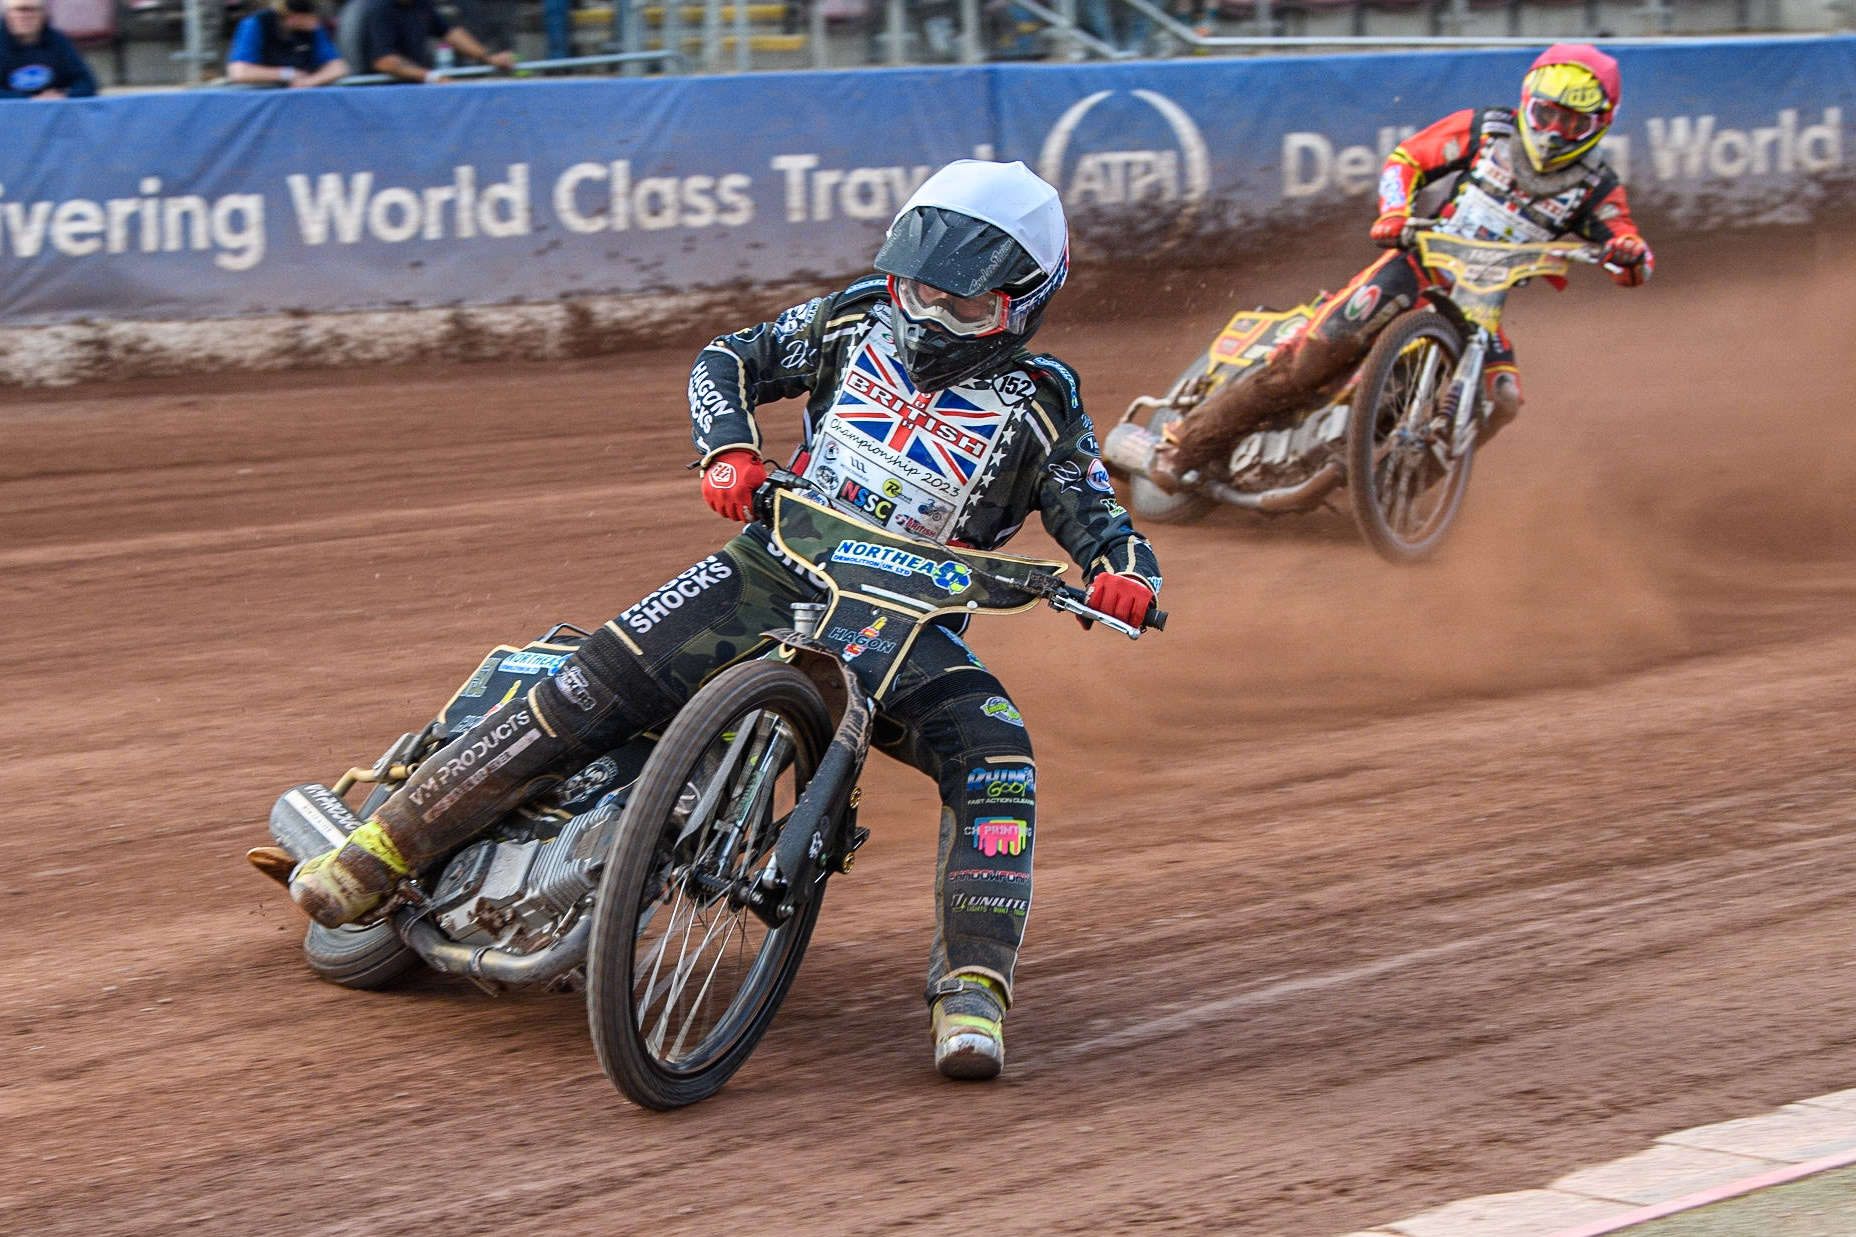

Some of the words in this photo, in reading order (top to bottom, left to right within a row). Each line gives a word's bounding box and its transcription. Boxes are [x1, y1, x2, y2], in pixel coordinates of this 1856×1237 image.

[1646, 107, 1843, 181] World
[287, 163, 531, 245] World
[553, 159, 756, 233] Class
[771, 144, 994, 222] Trav
[691, 360, 735, 417] HAGON
[998, 375, 1033, 397] 152
[849, 372, 985, 458] BRITISH
[830, 418, 921, 476] Championship
[921, 472, 960, 497] 2023
[842, 480, 892, 520] NSSC
[833, 555, 880, 568] DEMOLITION
[881, 563, 894, 571] UK
[895, 567, 911, 576] LTD
[838, 541, 962, 584] NORTHEAST
[628, 561, 733, 635] SHOCKS
[508, 652, 562, 668] NORTHEA
[828, 627, 897, 653] HAGON
[439, 710, 532, 786] PRODUCTS
[964, 826, 980, 836] CH
[967, 895, 1028, 911] UNILITE
